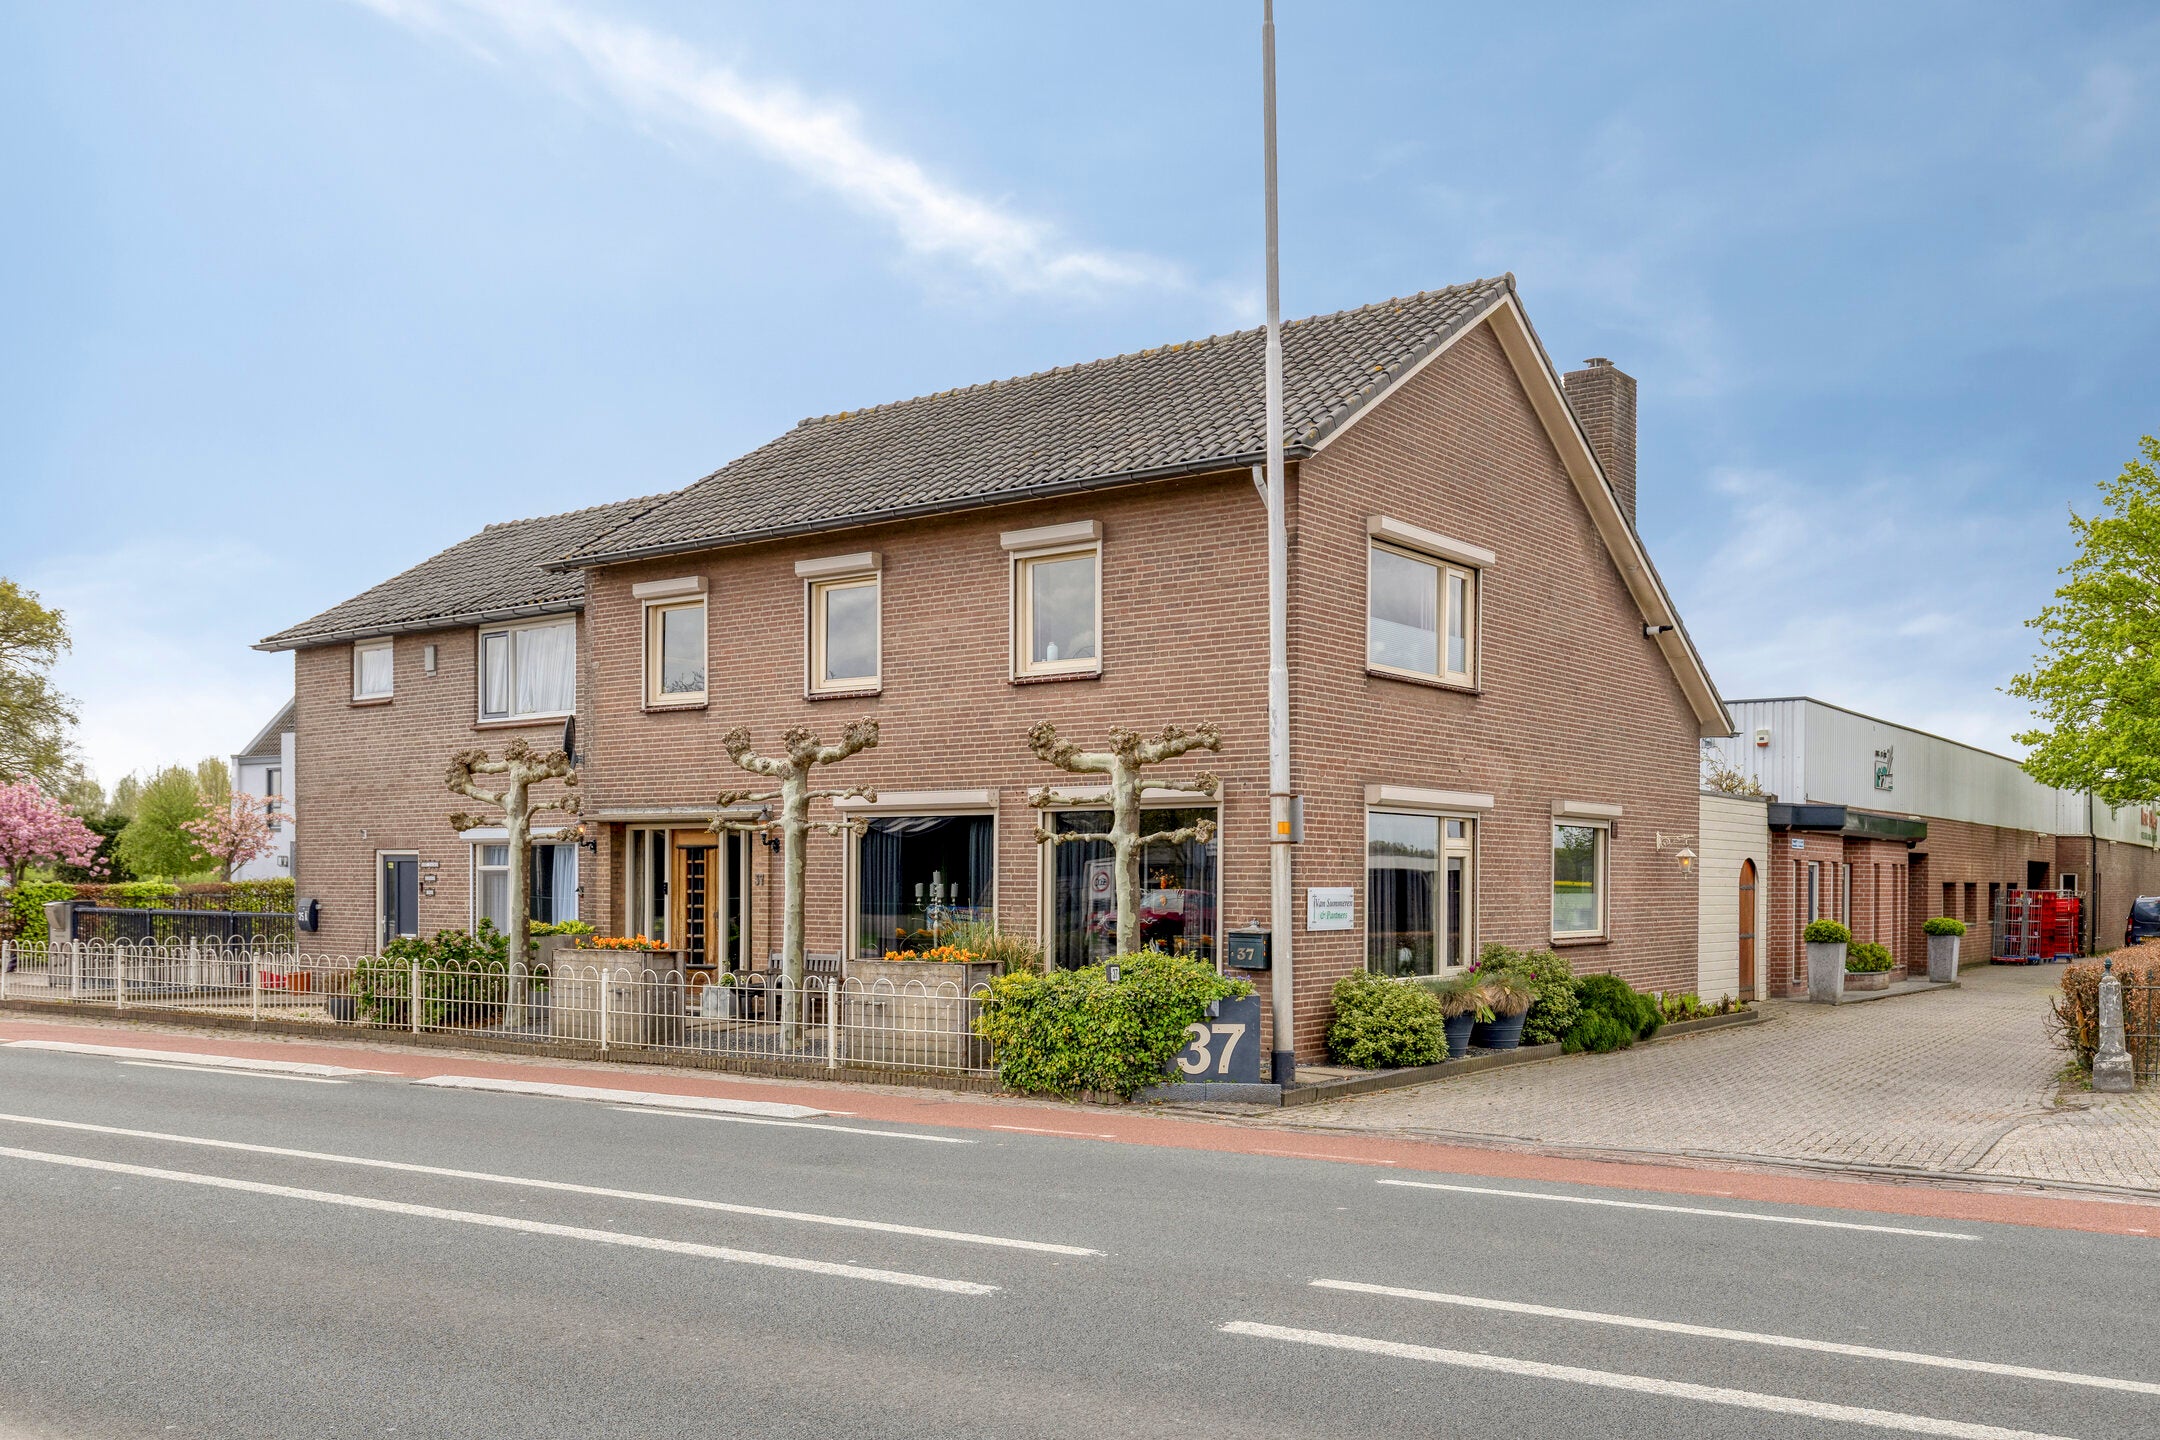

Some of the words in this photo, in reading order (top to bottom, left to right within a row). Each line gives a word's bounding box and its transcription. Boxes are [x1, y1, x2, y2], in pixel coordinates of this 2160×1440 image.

[755, 873, 764, 886] 37
[1237, 947, 1255, 961] 37
[1177, 1022, 1246, 1075] 37
